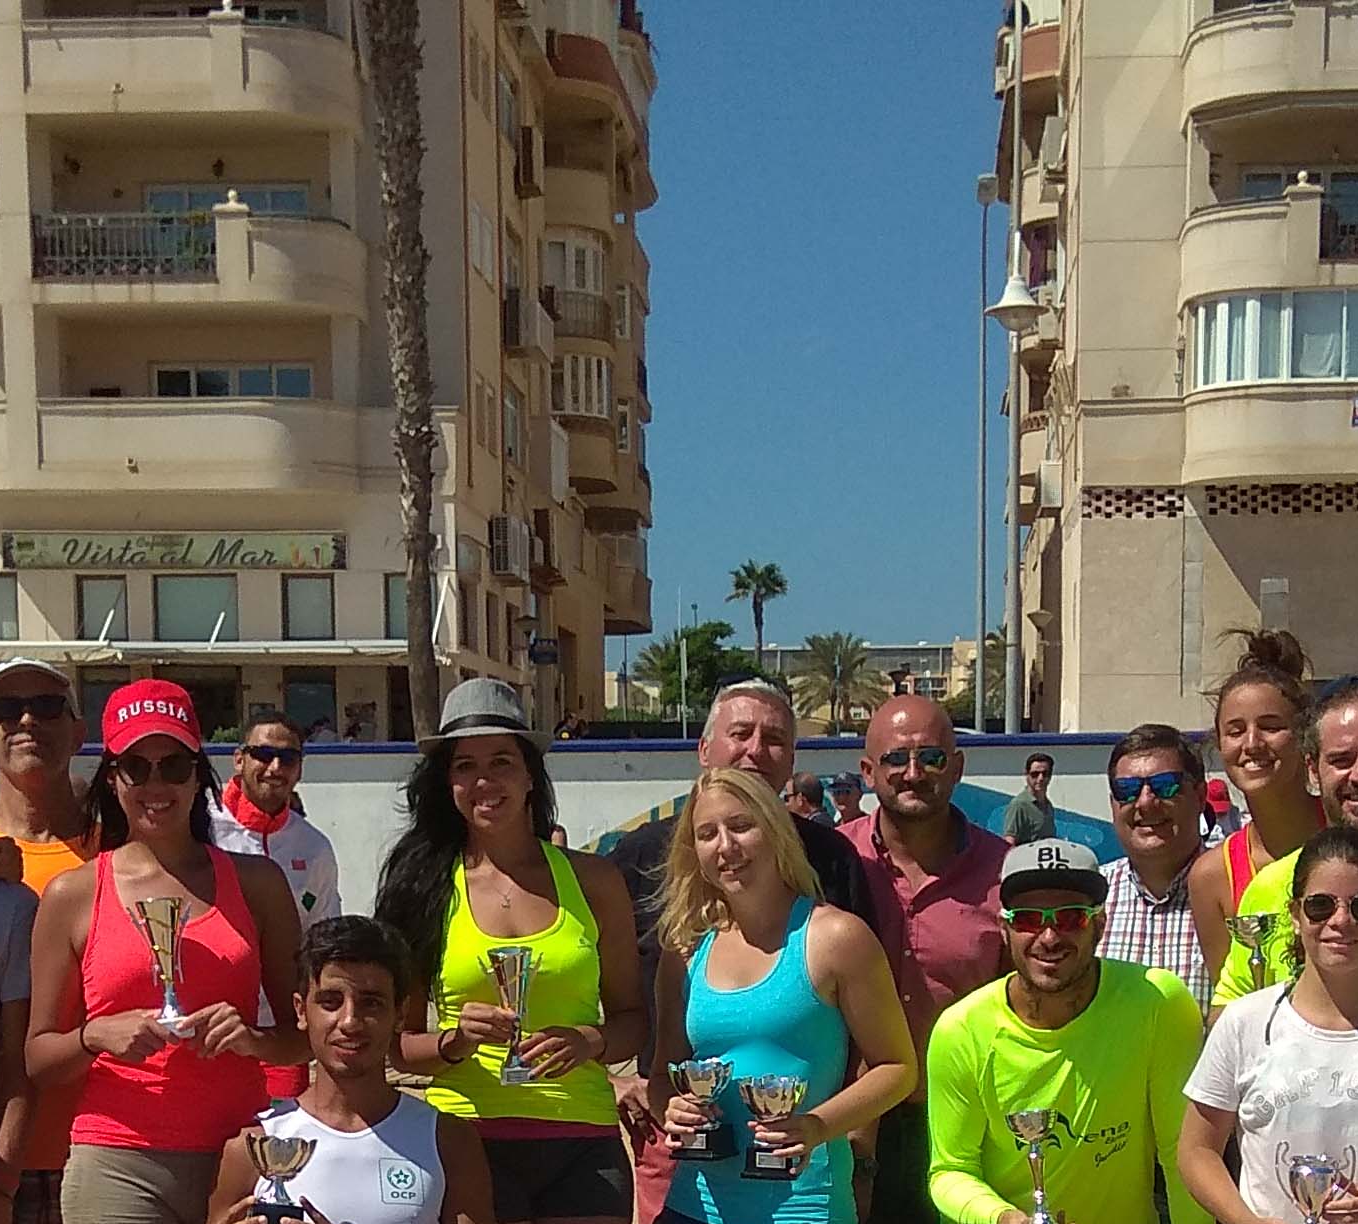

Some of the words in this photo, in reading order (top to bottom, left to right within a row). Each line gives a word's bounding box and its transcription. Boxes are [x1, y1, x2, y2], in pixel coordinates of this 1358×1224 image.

[60, 537, 148, 566] Vista
[158, 537, 193, 564] al
[202, 537, 280, 568] Mar
[117, 699, 189, 724] RUSSIA
[1038, 847, 1070, 863] BL
[390, 1191, 417, 1200] OCP
